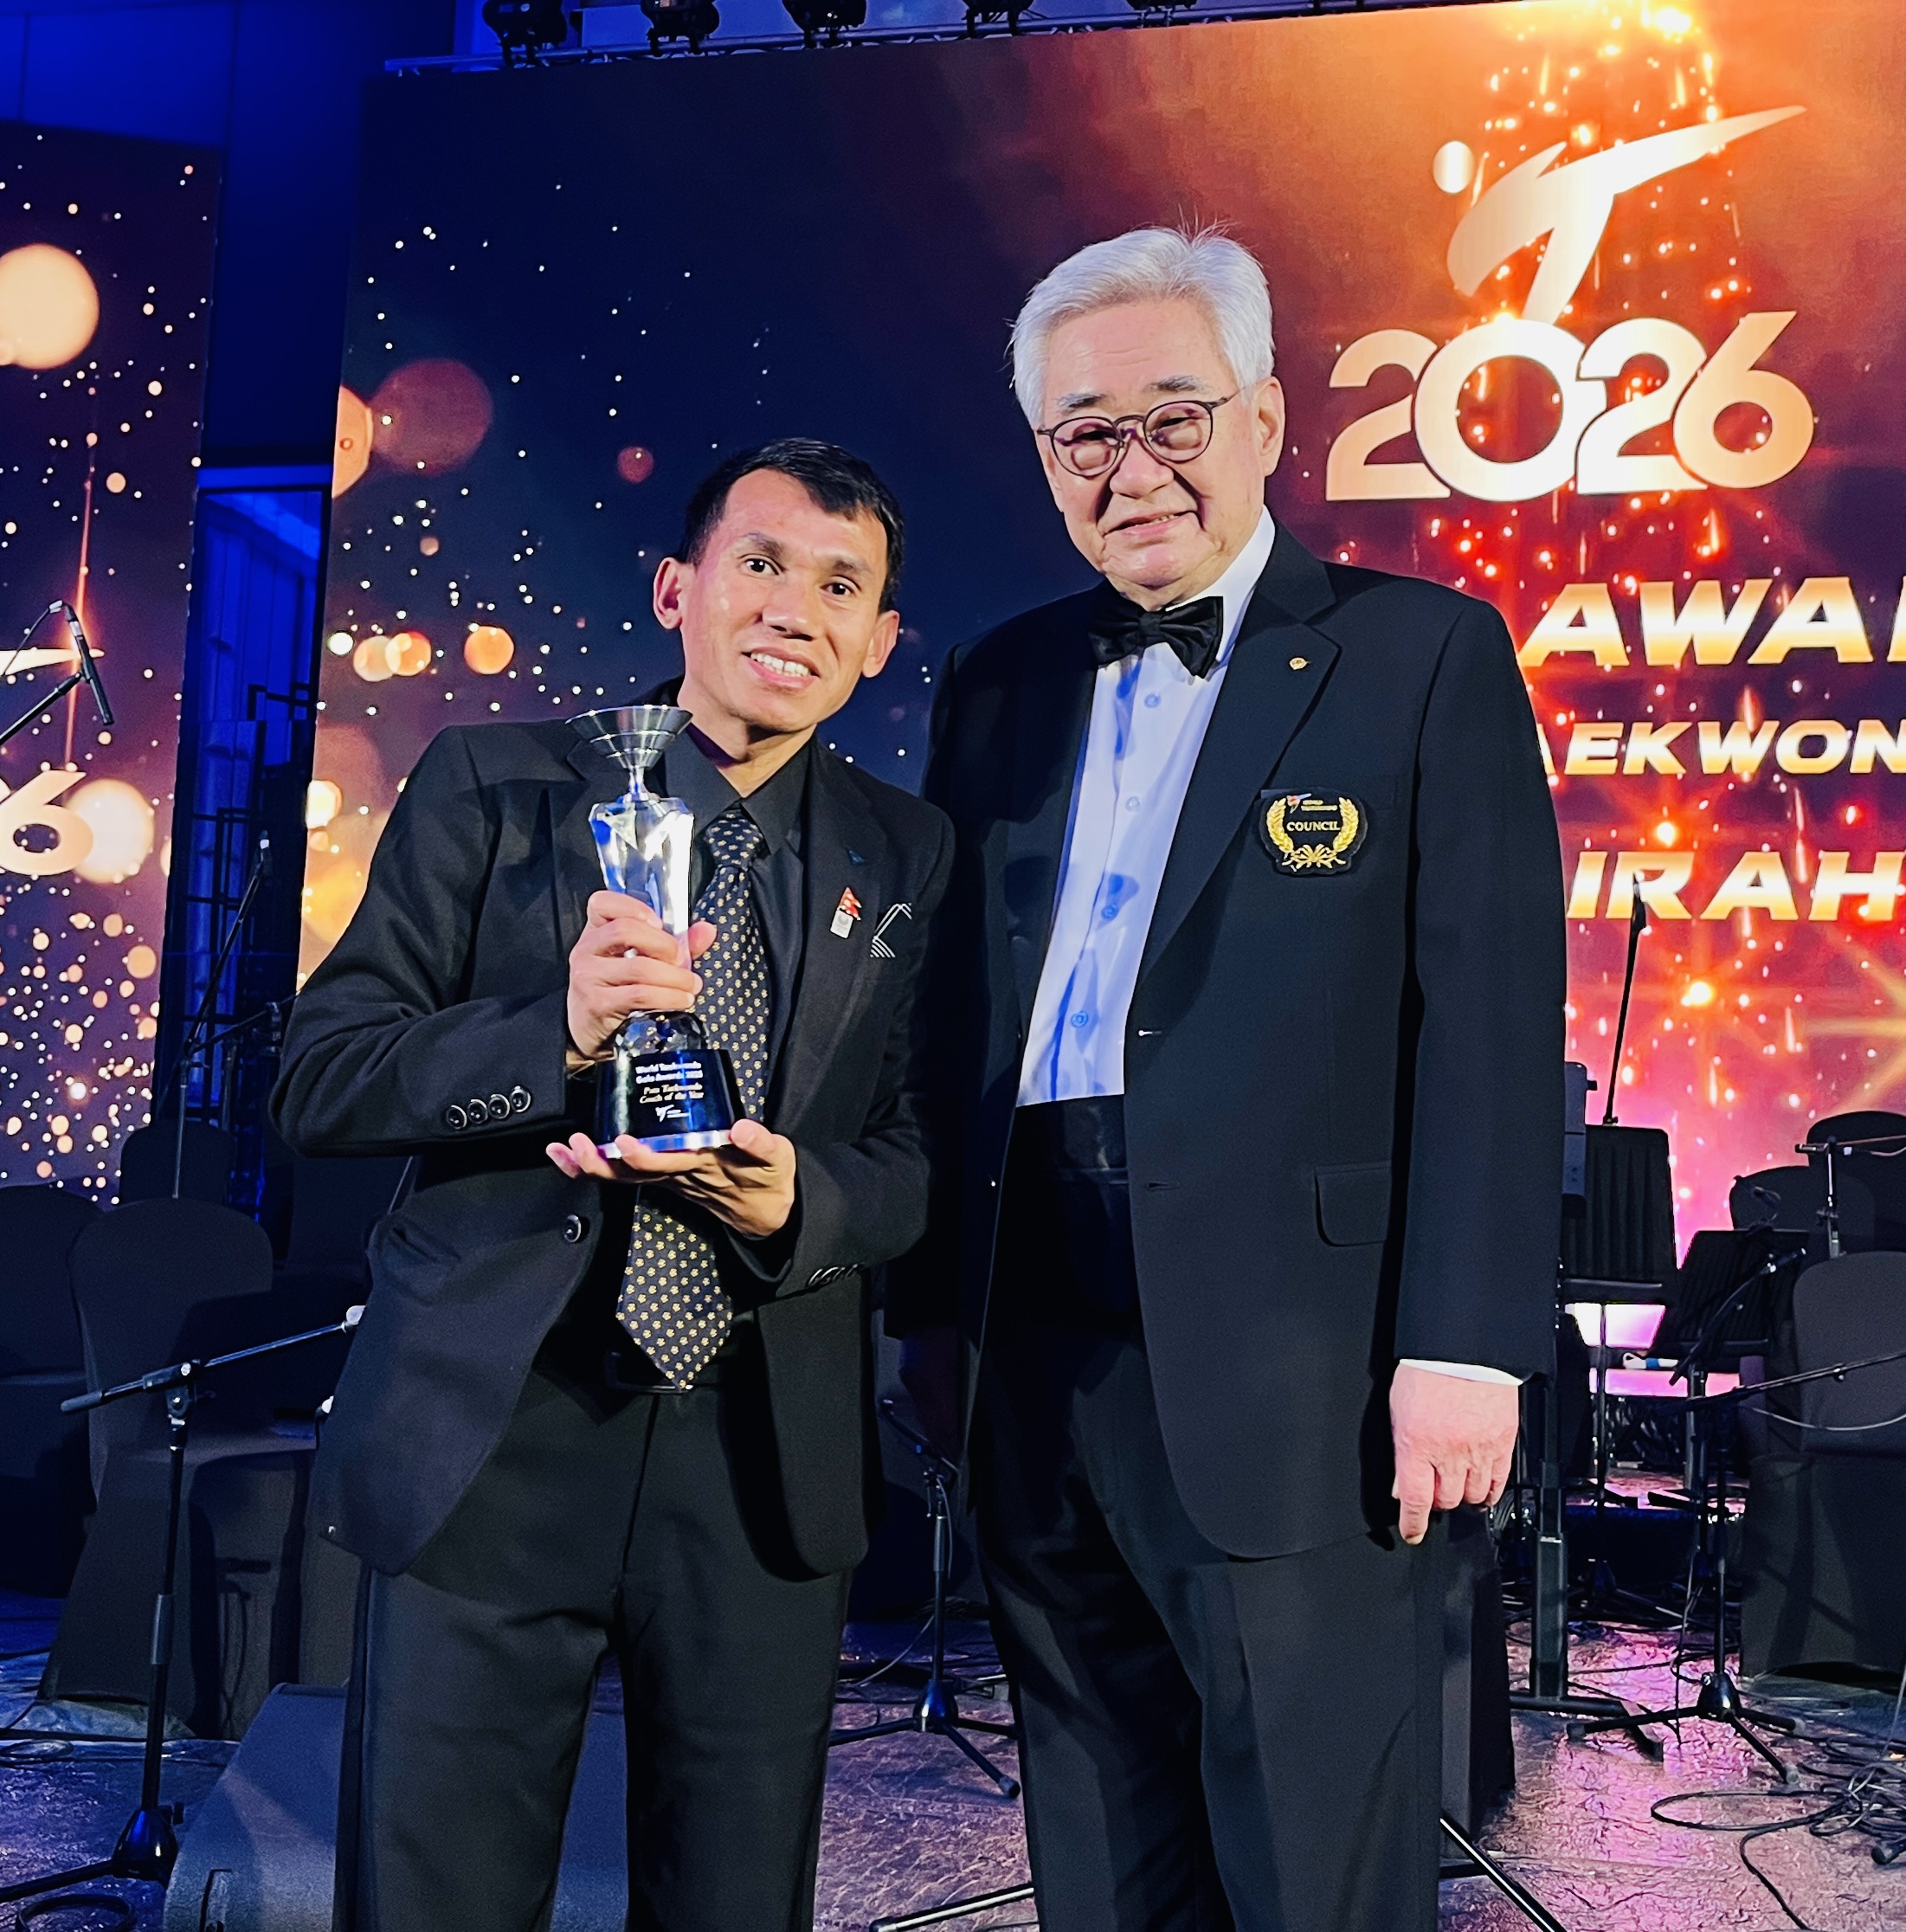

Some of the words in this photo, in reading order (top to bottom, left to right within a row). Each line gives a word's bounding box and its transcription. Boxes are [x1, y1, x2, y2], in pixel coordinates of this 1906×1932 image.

[1325, 310, 1814, 502] 2026
[1516, 576, 1906, 667] AWA
[1536, 719, 1906, 775] EKWON
[0, 769, 93, 876] 6
[1286, 821, 1341, 832] COUNCIL
